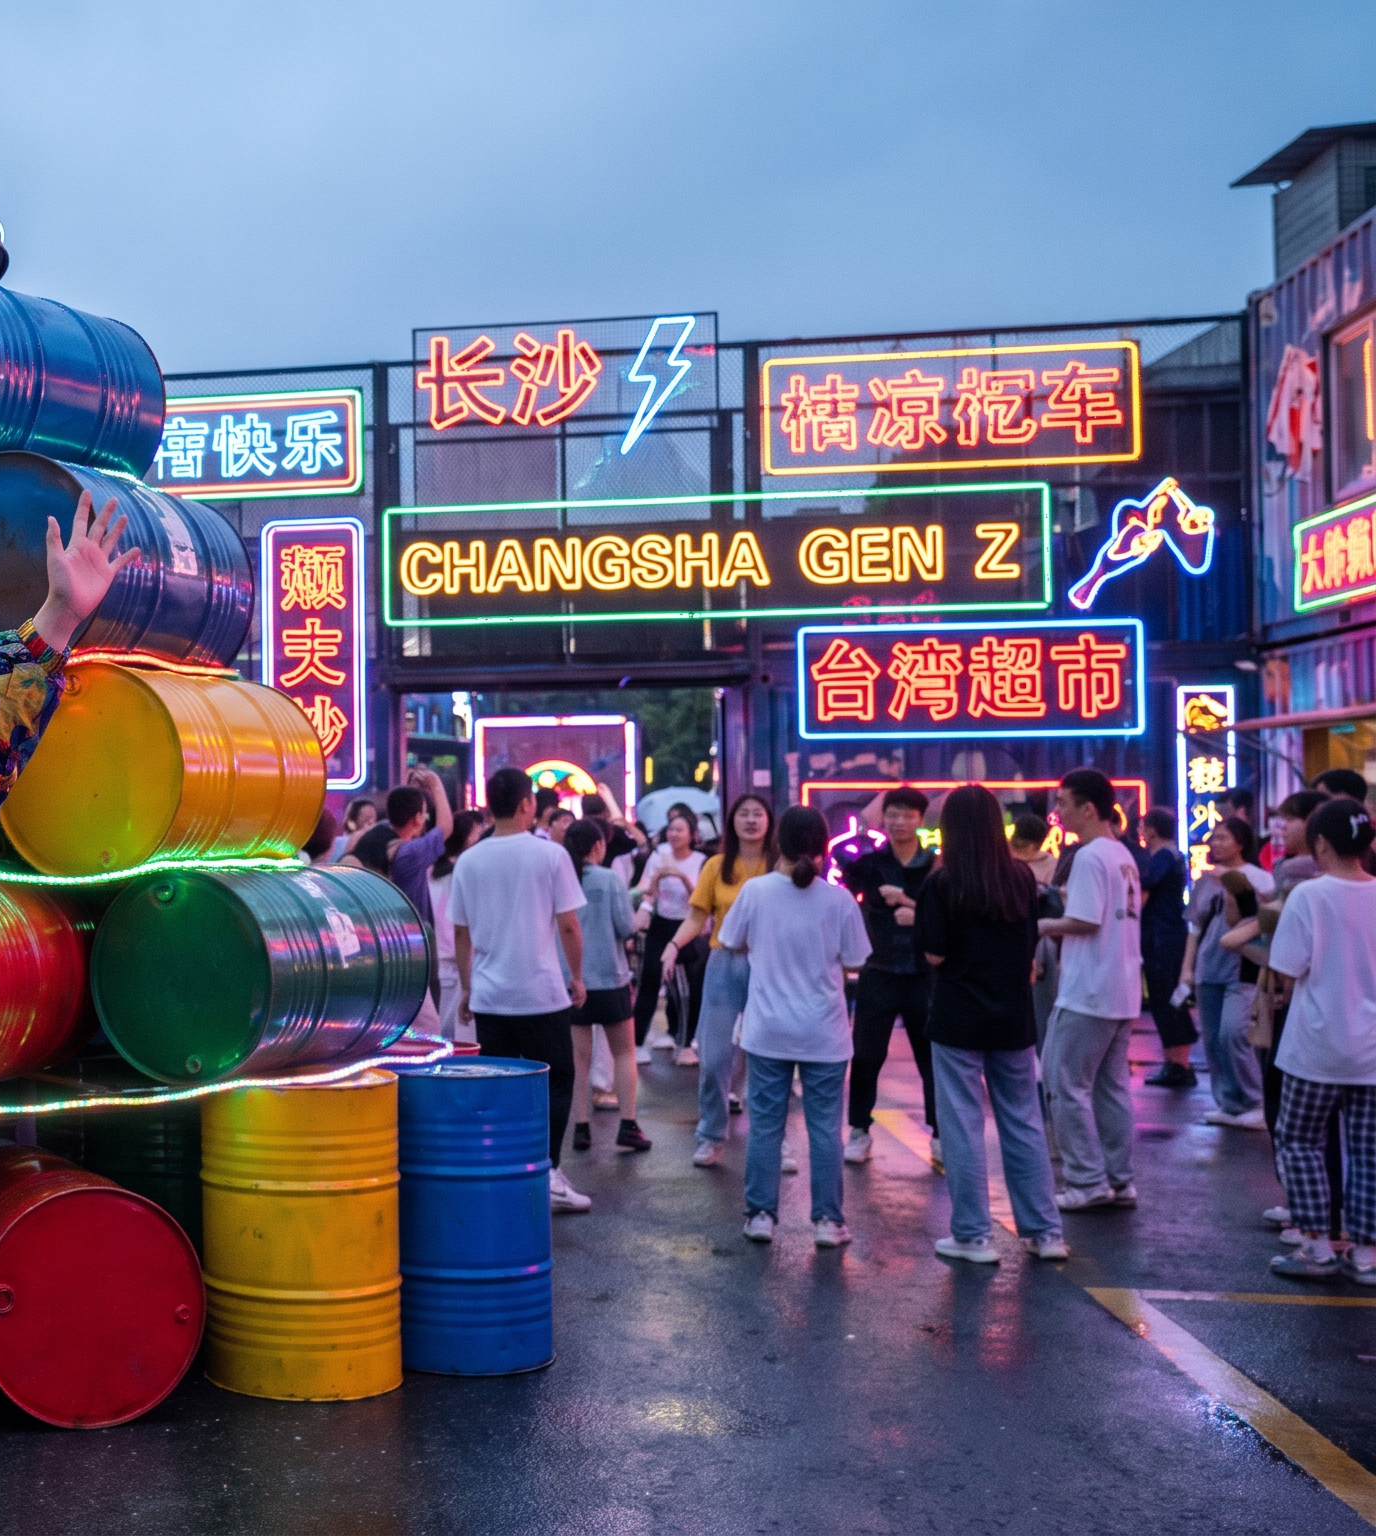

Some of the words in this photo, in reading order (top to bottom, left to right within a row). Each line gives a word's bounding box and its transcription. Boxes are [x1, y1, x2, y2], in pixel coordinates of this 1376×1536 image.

[417, 329, 603, 431] 长沙
[400, 531, 771, 596] CHANGSHA
[798, 524, 944, 585] GEN
[974, 522, 1021, 580] Z
[810, 633, 1127, 722] 台湾超市
